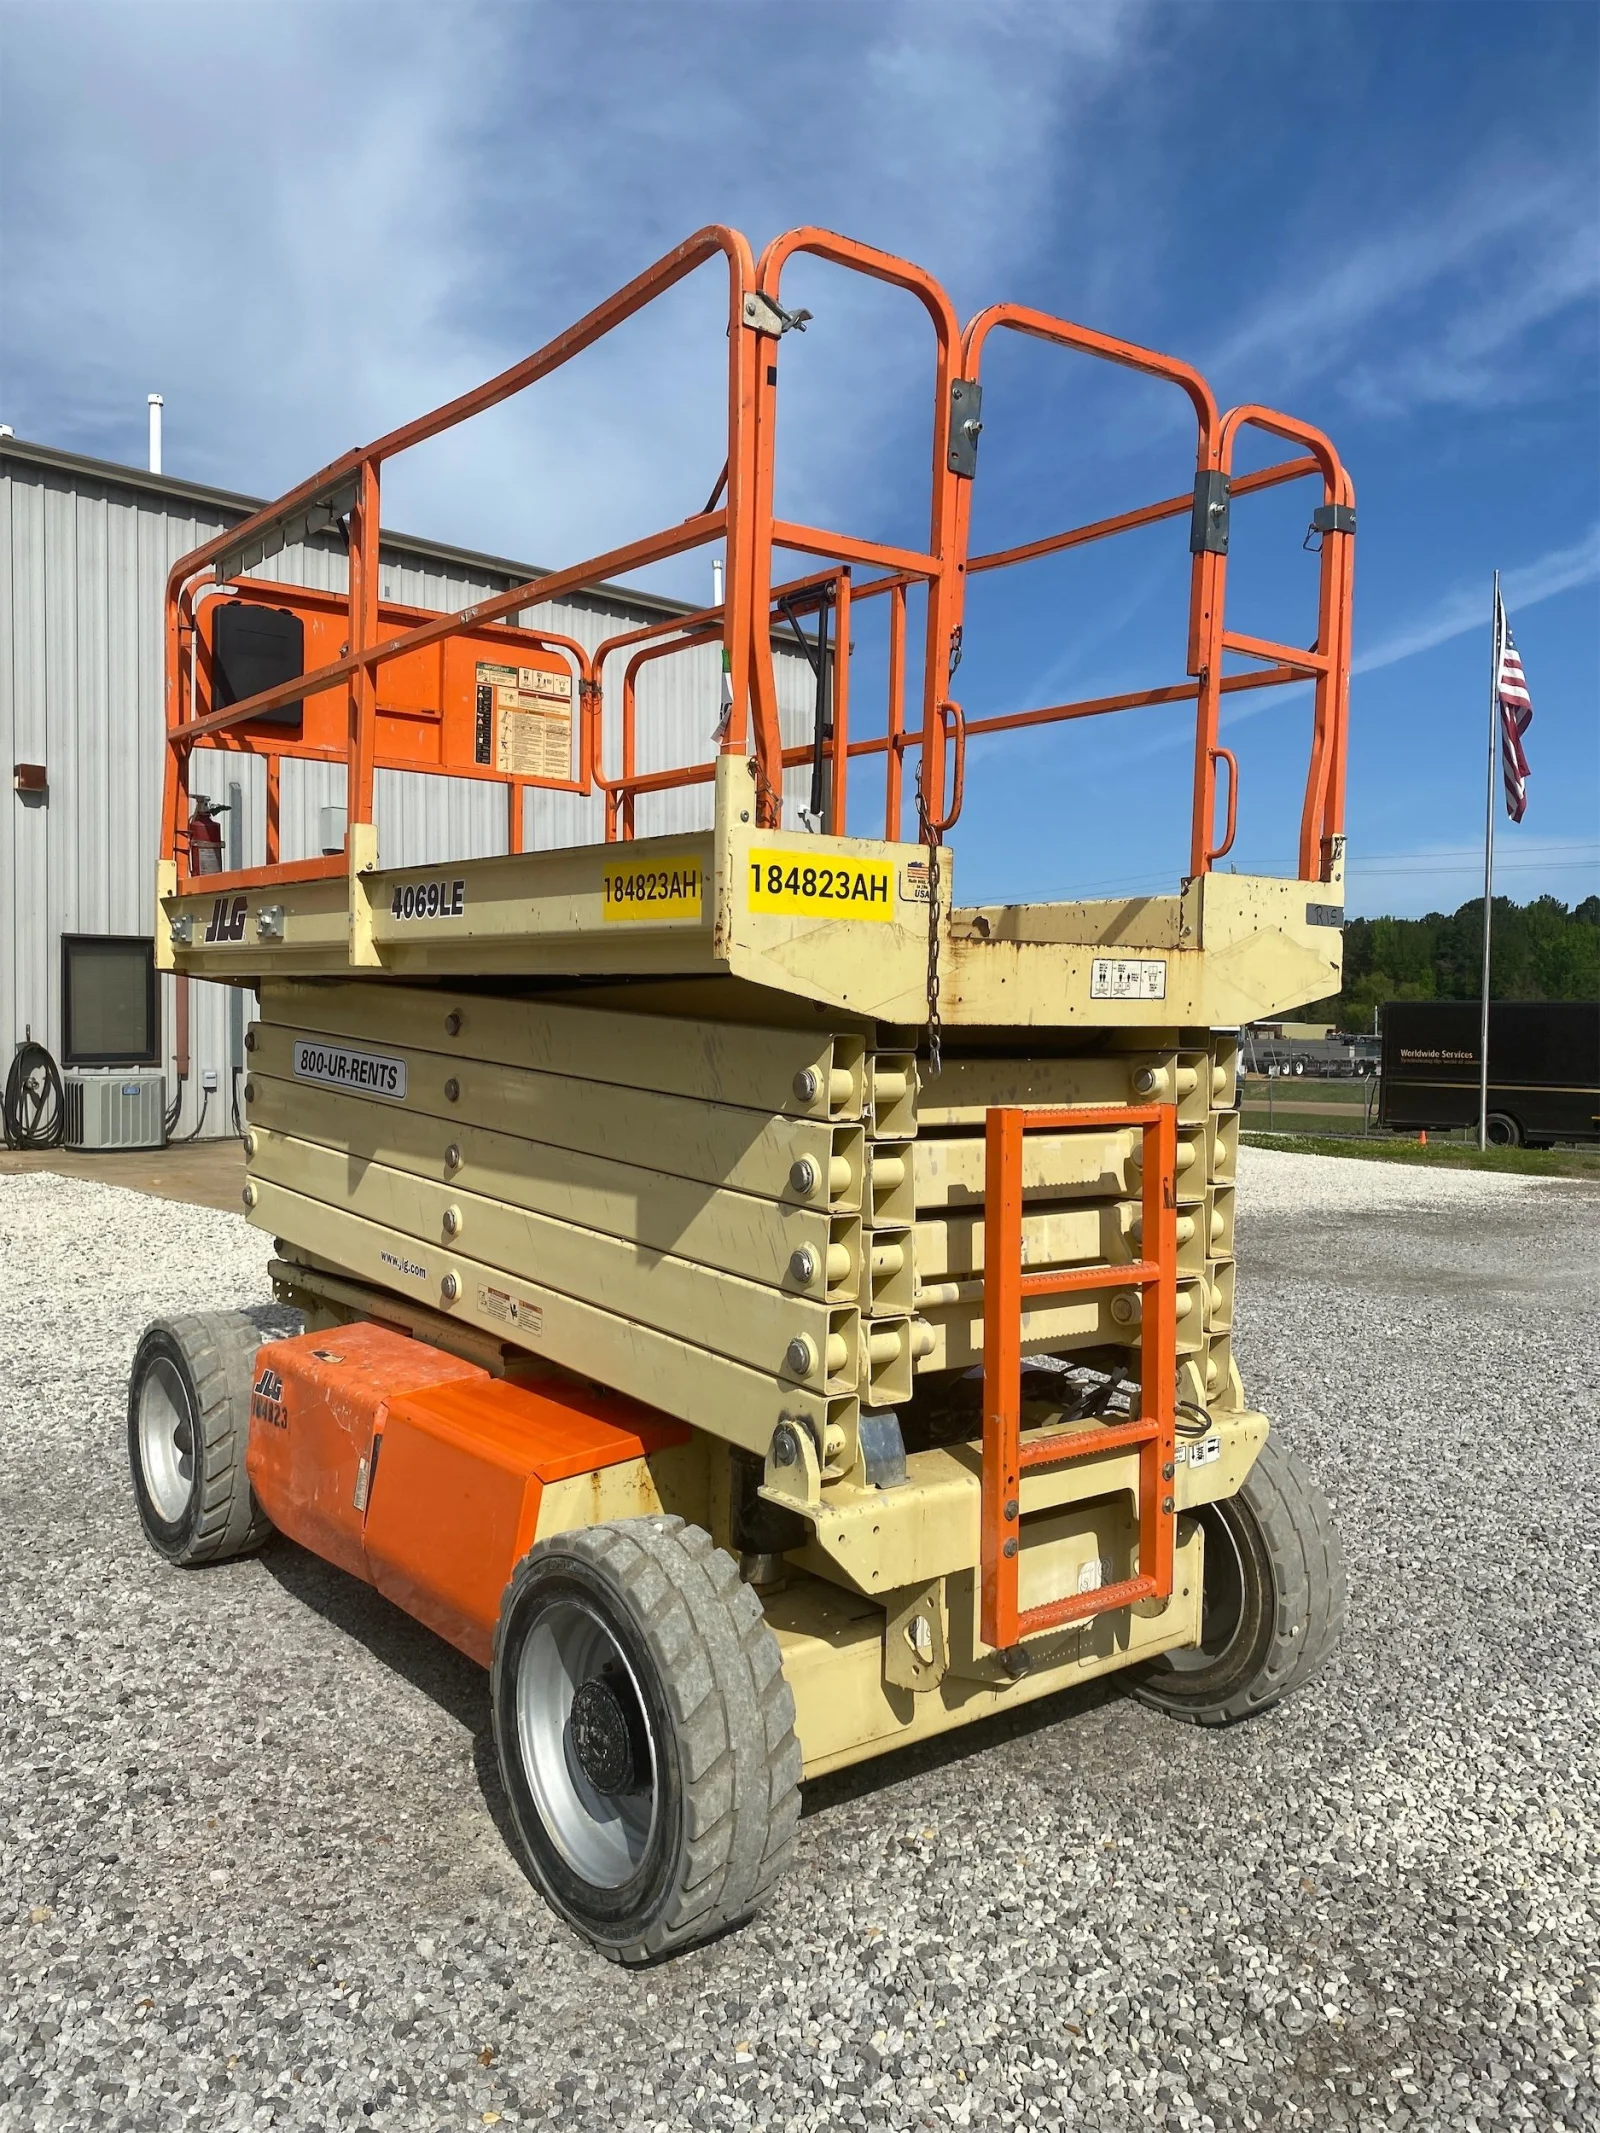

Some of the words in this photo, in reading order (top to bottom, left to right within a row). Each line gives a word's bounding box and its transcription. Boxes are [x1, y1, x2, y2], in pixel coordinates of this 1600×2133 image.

[392, 880, 465, 920] 4069LE
[604, 869, 697, 903] 184823AH
[751, 864, 887, 902] 184823AH
[914, 889, 930, 899] USA
[205, 896, 248, 943] JLG
[300, 1049, 399, 1090] 800-UR-RENTS
[1400, 1048, 1440, 1058] Worldwide
[1441, 1050, 1474, 1059] Services
[380, 1250, 426, 1279] www.jlg.com
[254, 1368, 284, 1403] JLG
